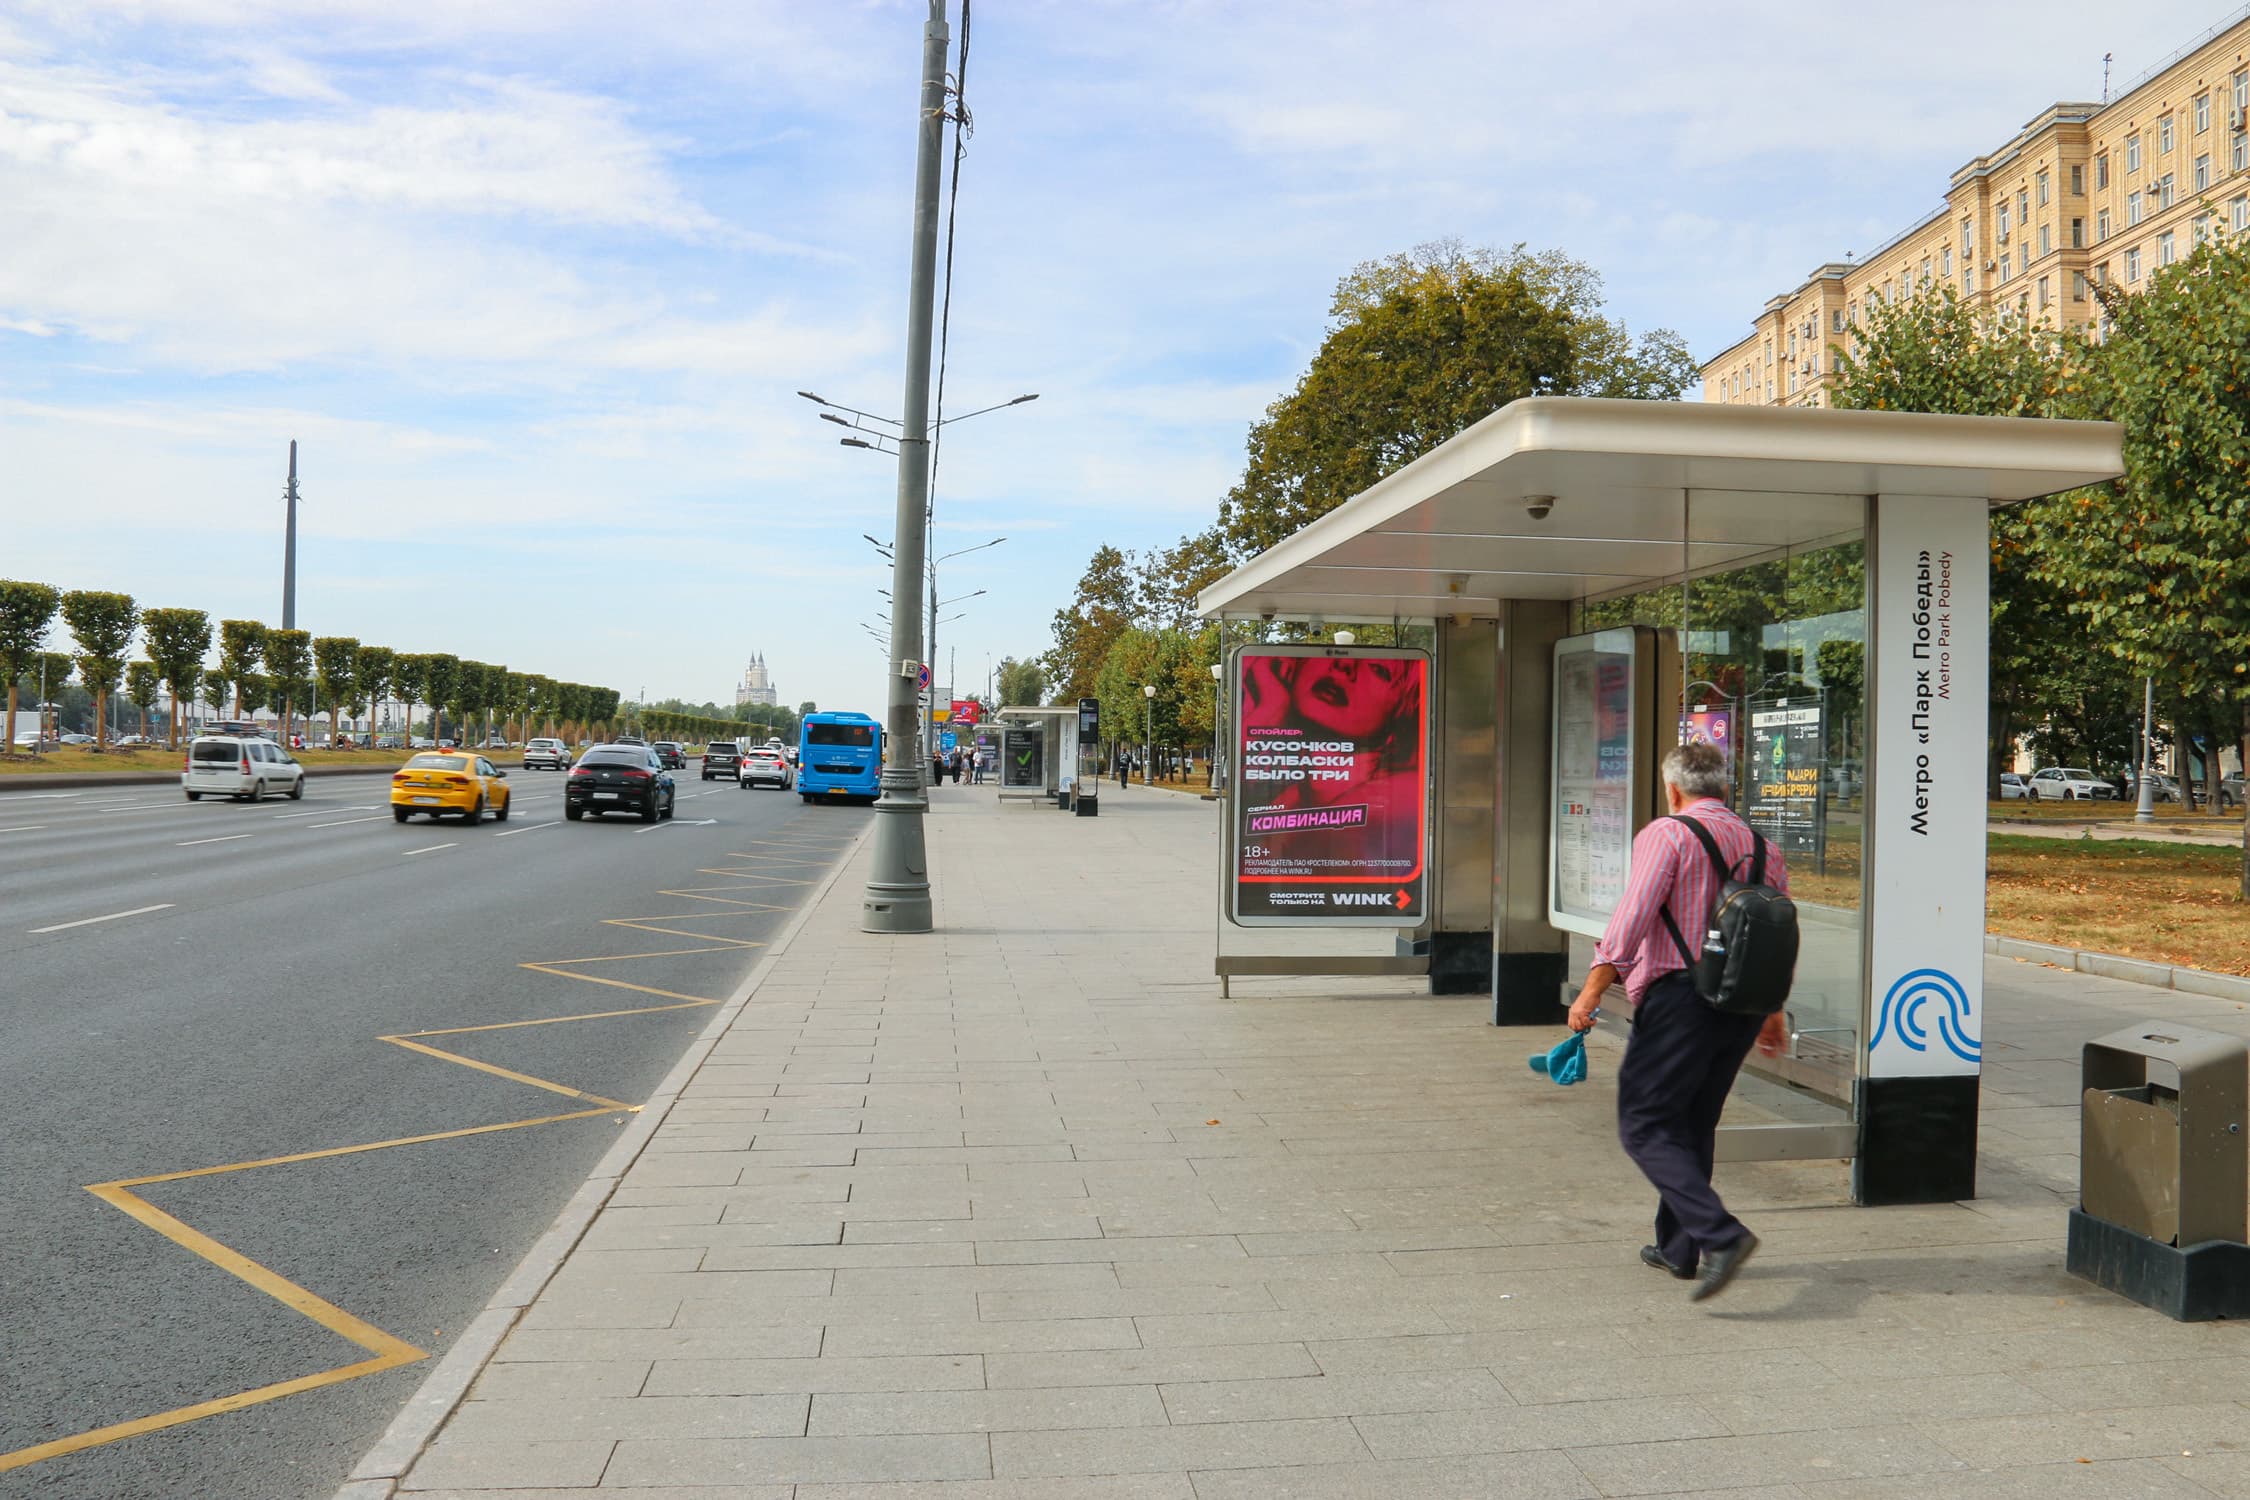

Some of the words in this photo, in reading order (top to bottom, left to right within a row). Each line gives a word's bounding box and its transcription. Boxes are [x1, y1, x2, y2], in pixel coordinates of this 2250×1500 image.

[1938, 551, 1953, 608] Pobedy
[1912, 550, 1933, 659] Победы»
[1938, 613, 1950, 647] Park
[1938, 652, 1950, 700] Metro
[1911, 669, 1933, 744] «Парк
[1246, 740, 1355, 752] КУСОЧКОВ
[1245, 755, 1354, 767] КОЛБАСКИ
[1245, 769, 1306, 780] БЫЛО
[1308, 770, 1350, 781] ТРИ
[1910, 754, 1933, 836] Метро
[1247, 803, 1285, 812] СЕРИАЛ
[1251, 809, 1363, 831] КОМБИНАЦИЯ
[1244, 845, 1271, 858] 18+
[1332, 893, 1393, 905] WINK
